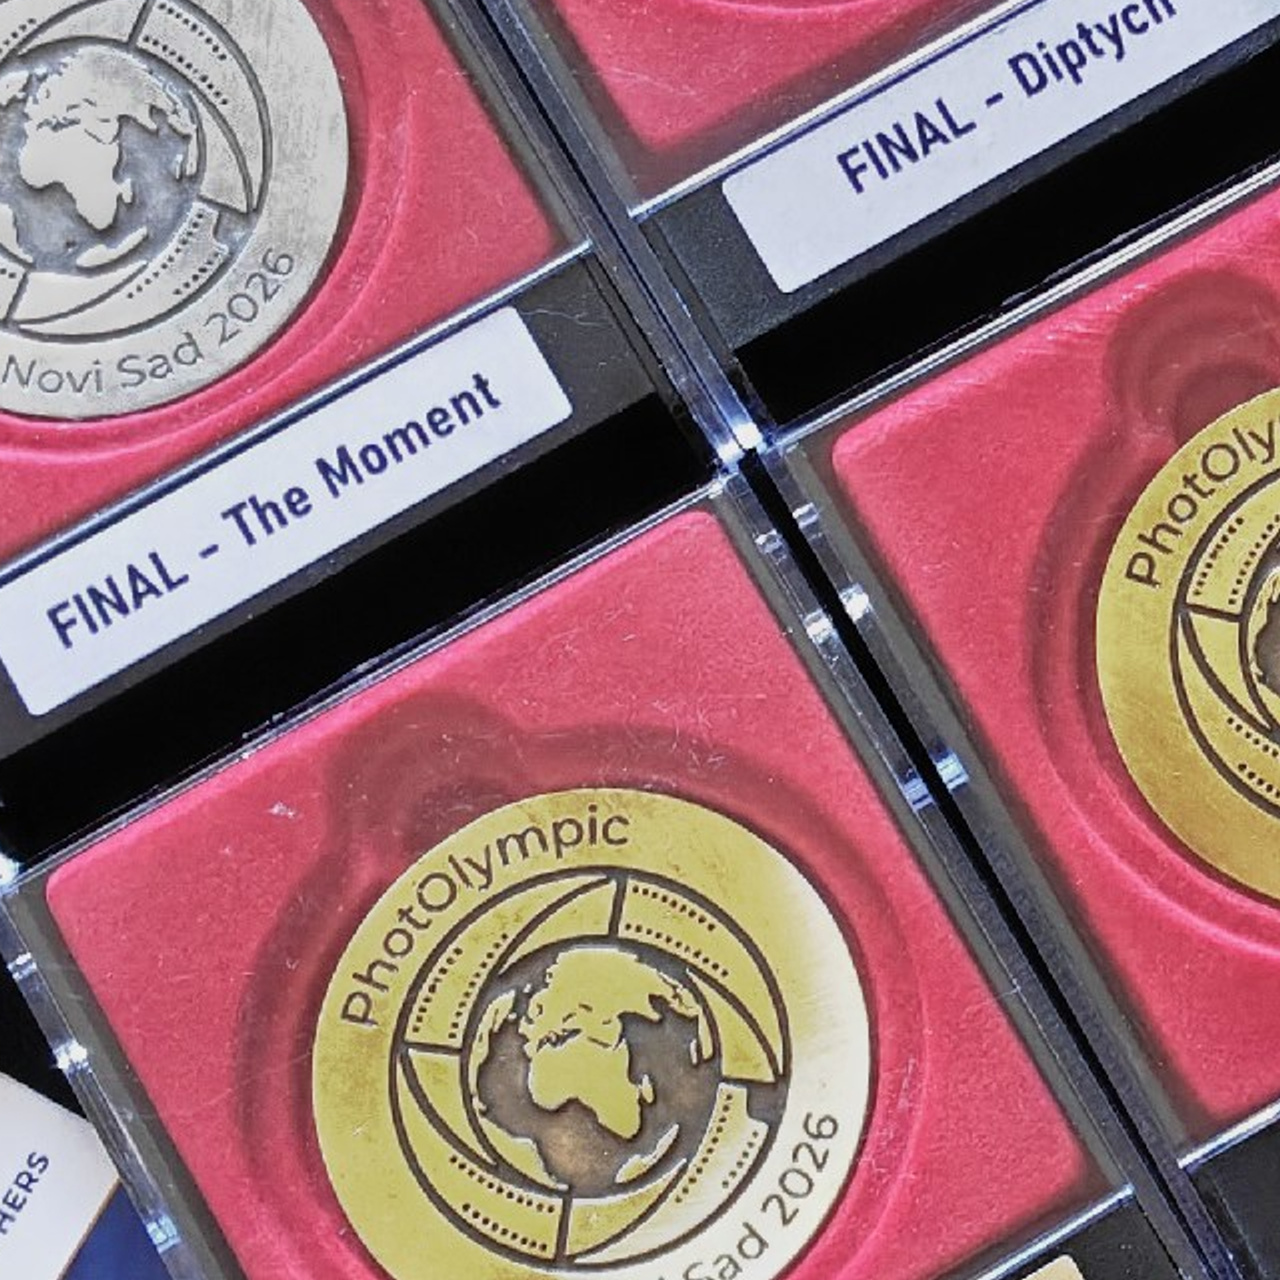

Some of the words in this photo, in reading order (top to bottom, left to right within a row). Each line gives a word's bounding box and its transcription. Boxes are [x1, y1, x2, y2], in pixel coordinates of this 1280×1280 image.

[836, 98, 978, 194] FINAL
[984, 90, 1005, 108] -
[1, 353, 102, 396] Novi
[116, 333, 203, 389] Sad
[203, 248, 295, 346] 2026
[46, 551, 189, 649] FINAL
[199, 543, 220, 560] -
[221, 484, 314, 548] The
[315, 372, 502, 498] Moment
[341, 803, 631, 1028] PhotOlympic
[762, 1110, 840, 1227] 2026
